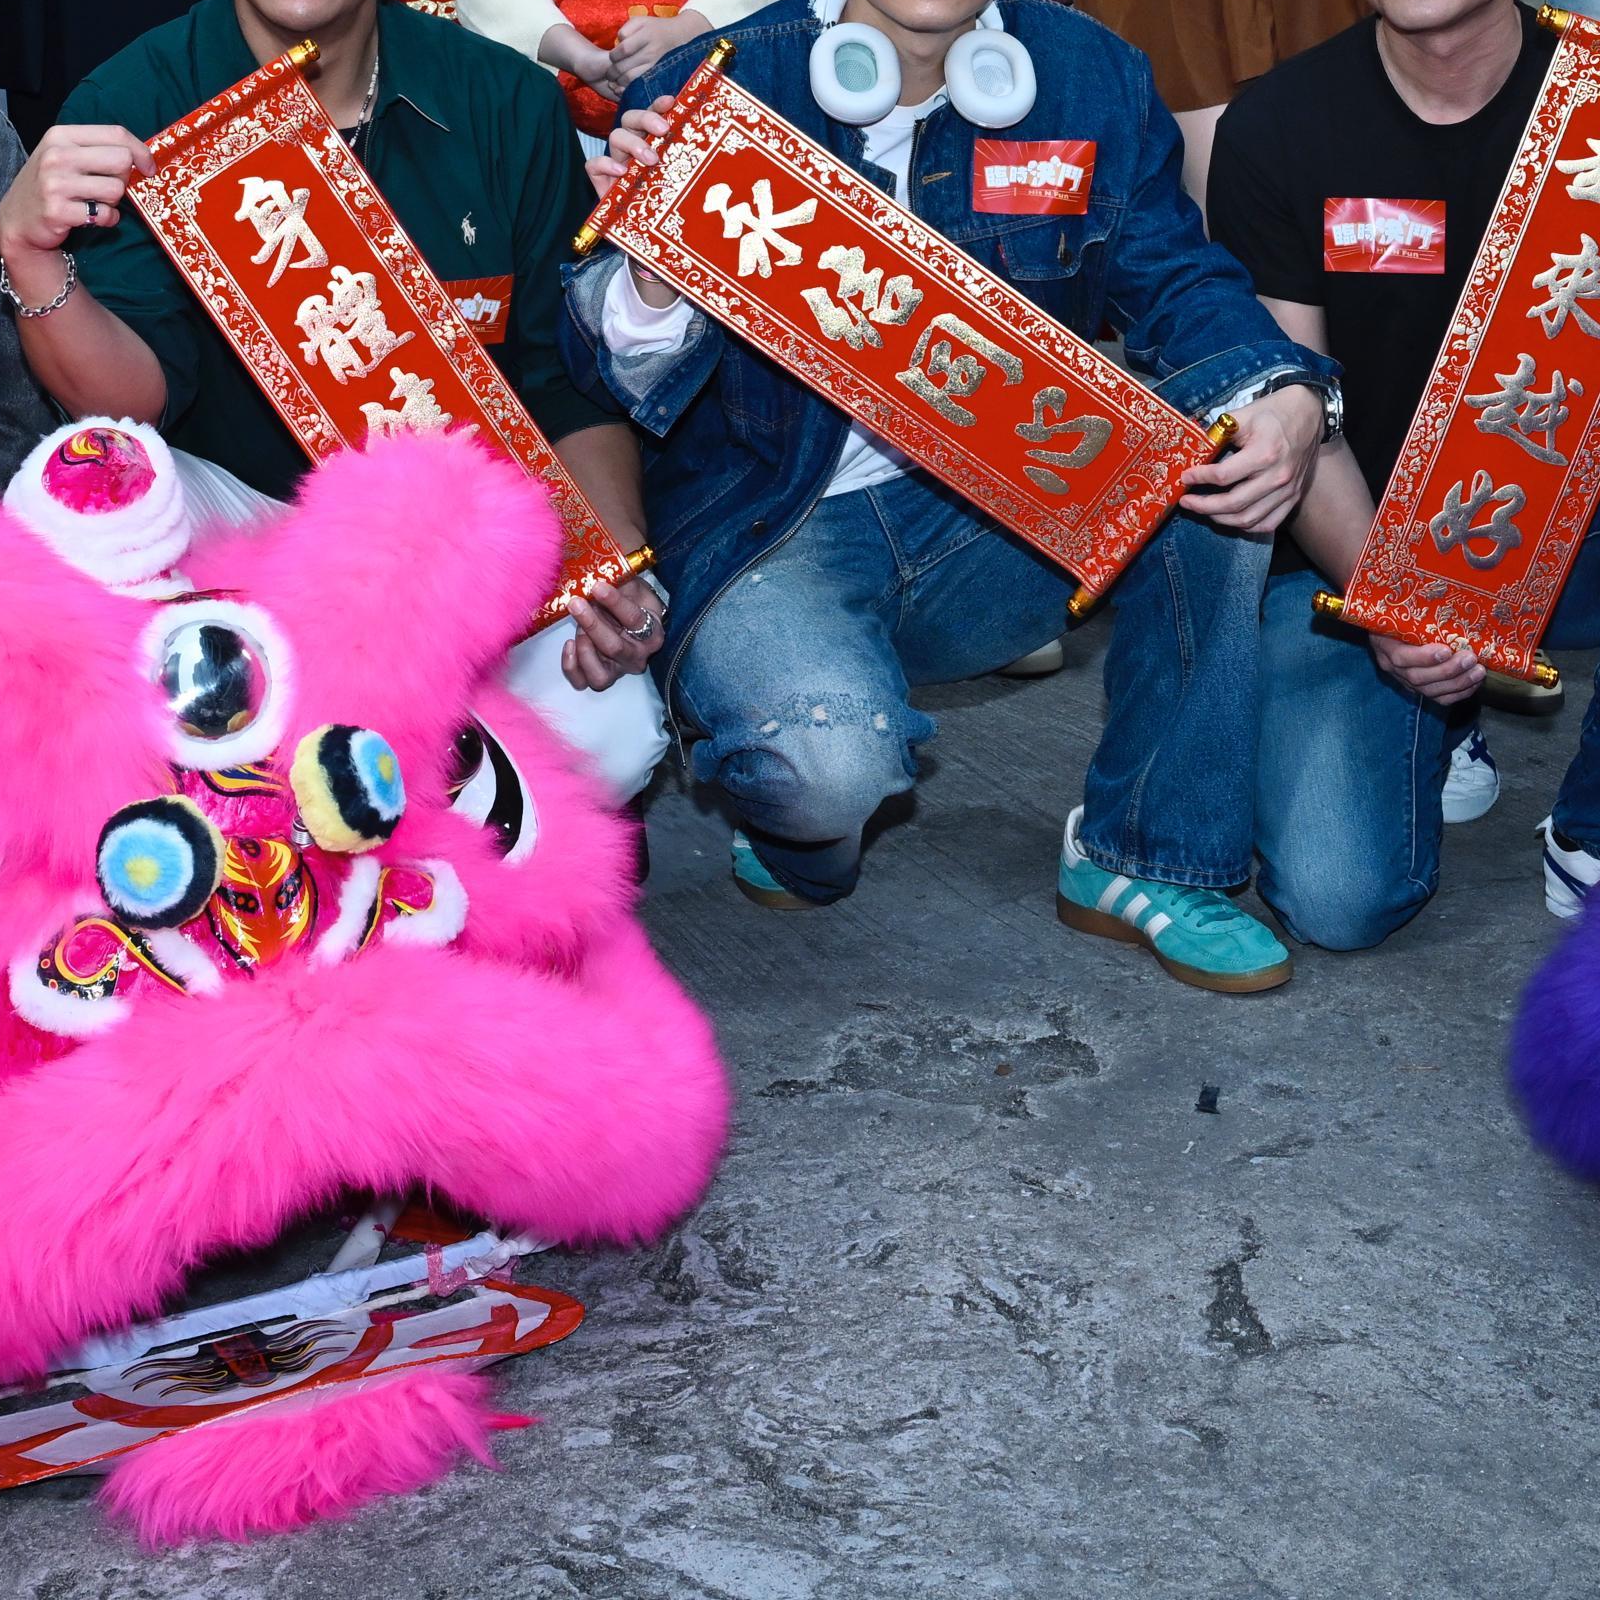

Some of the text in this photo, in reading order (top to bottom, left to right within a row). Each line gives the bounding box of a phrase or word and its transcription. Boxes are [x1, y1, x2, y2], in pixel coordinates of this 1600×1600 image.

[984, 155, 1085, 192] 臨時決鬥
[454, 292, 502, 324] 決鬥
[703, 178, 1115, 495] 永結同心
